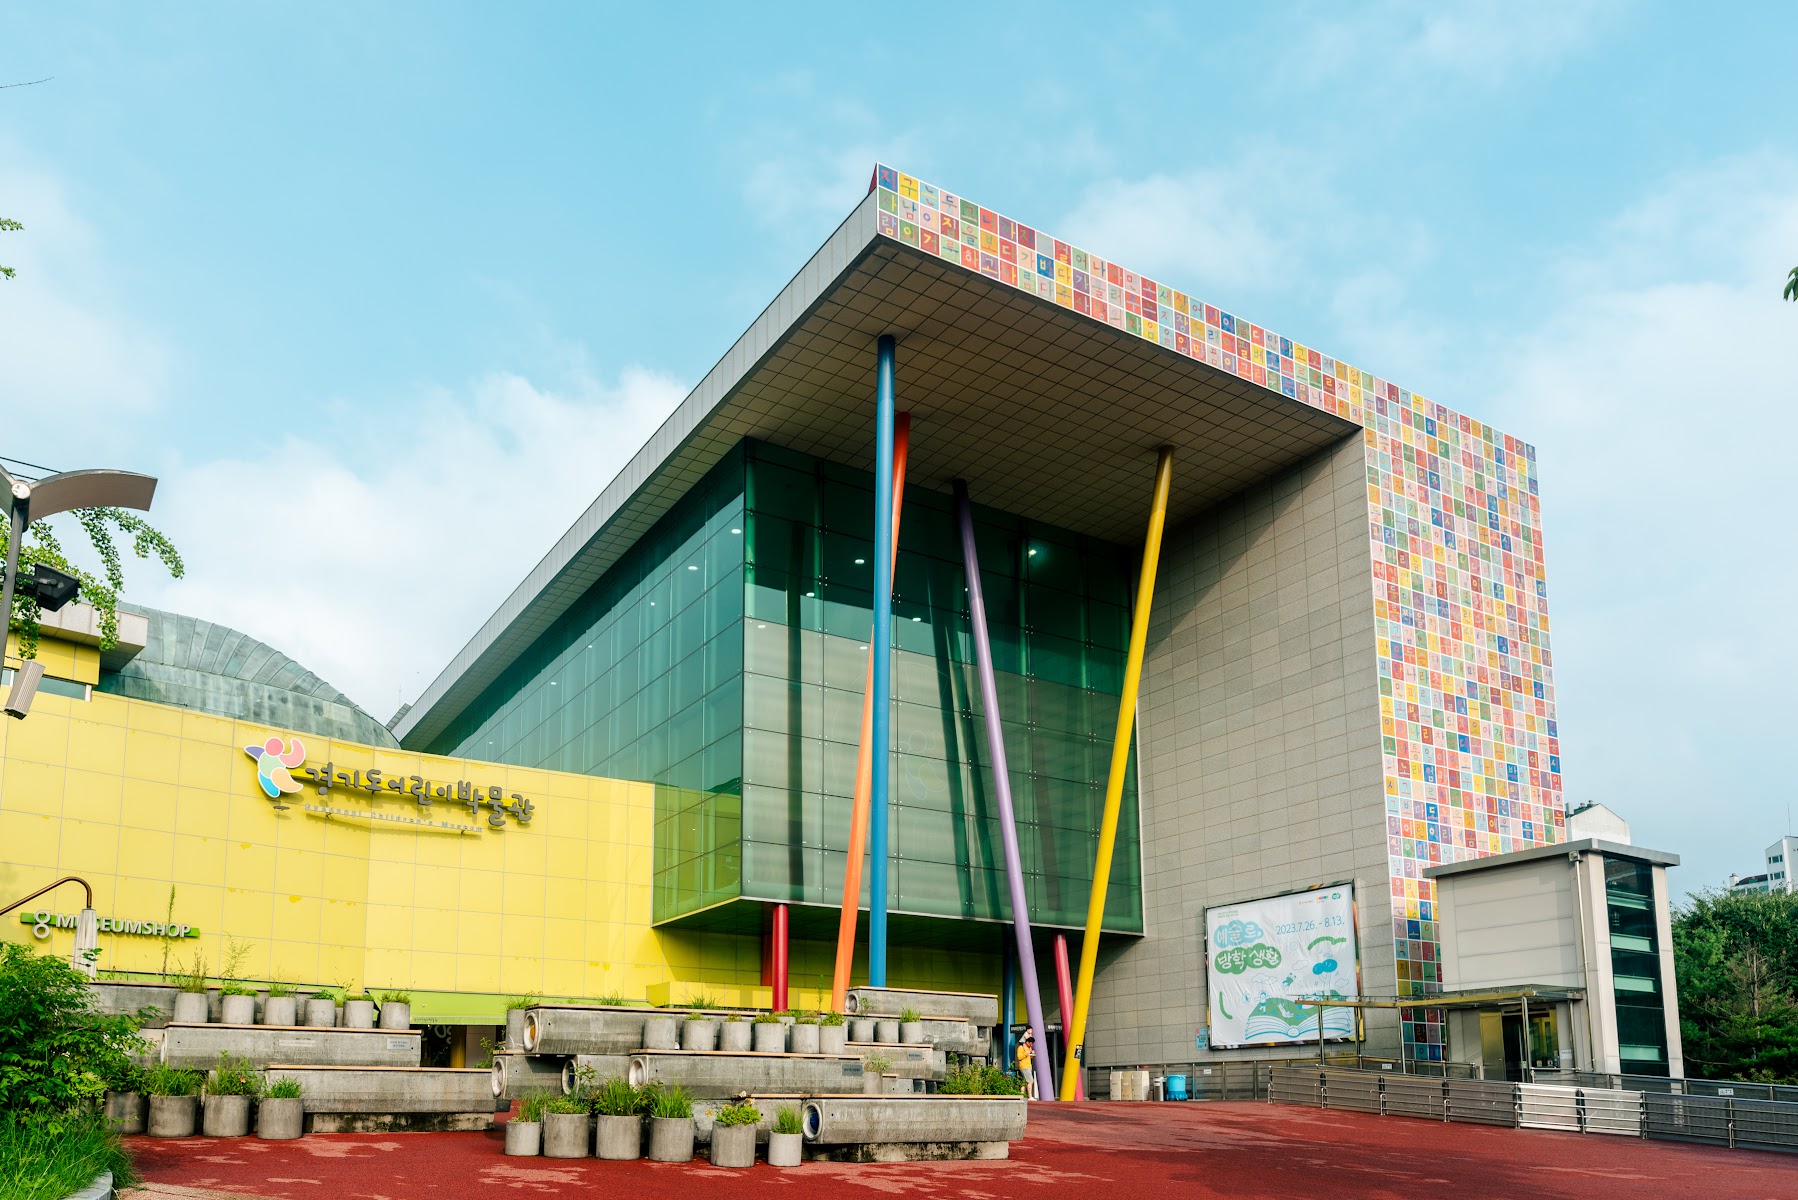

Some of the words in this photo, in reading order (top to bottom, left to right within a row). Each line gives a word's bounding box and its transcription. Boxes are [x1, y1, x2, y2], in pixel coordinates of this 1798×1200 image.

[305, 762, 535, 826] 경기도어린이박물관
[55, 912, 191, 938] MEUMSHOP
[1217, 949, 1247, 970] 방학
